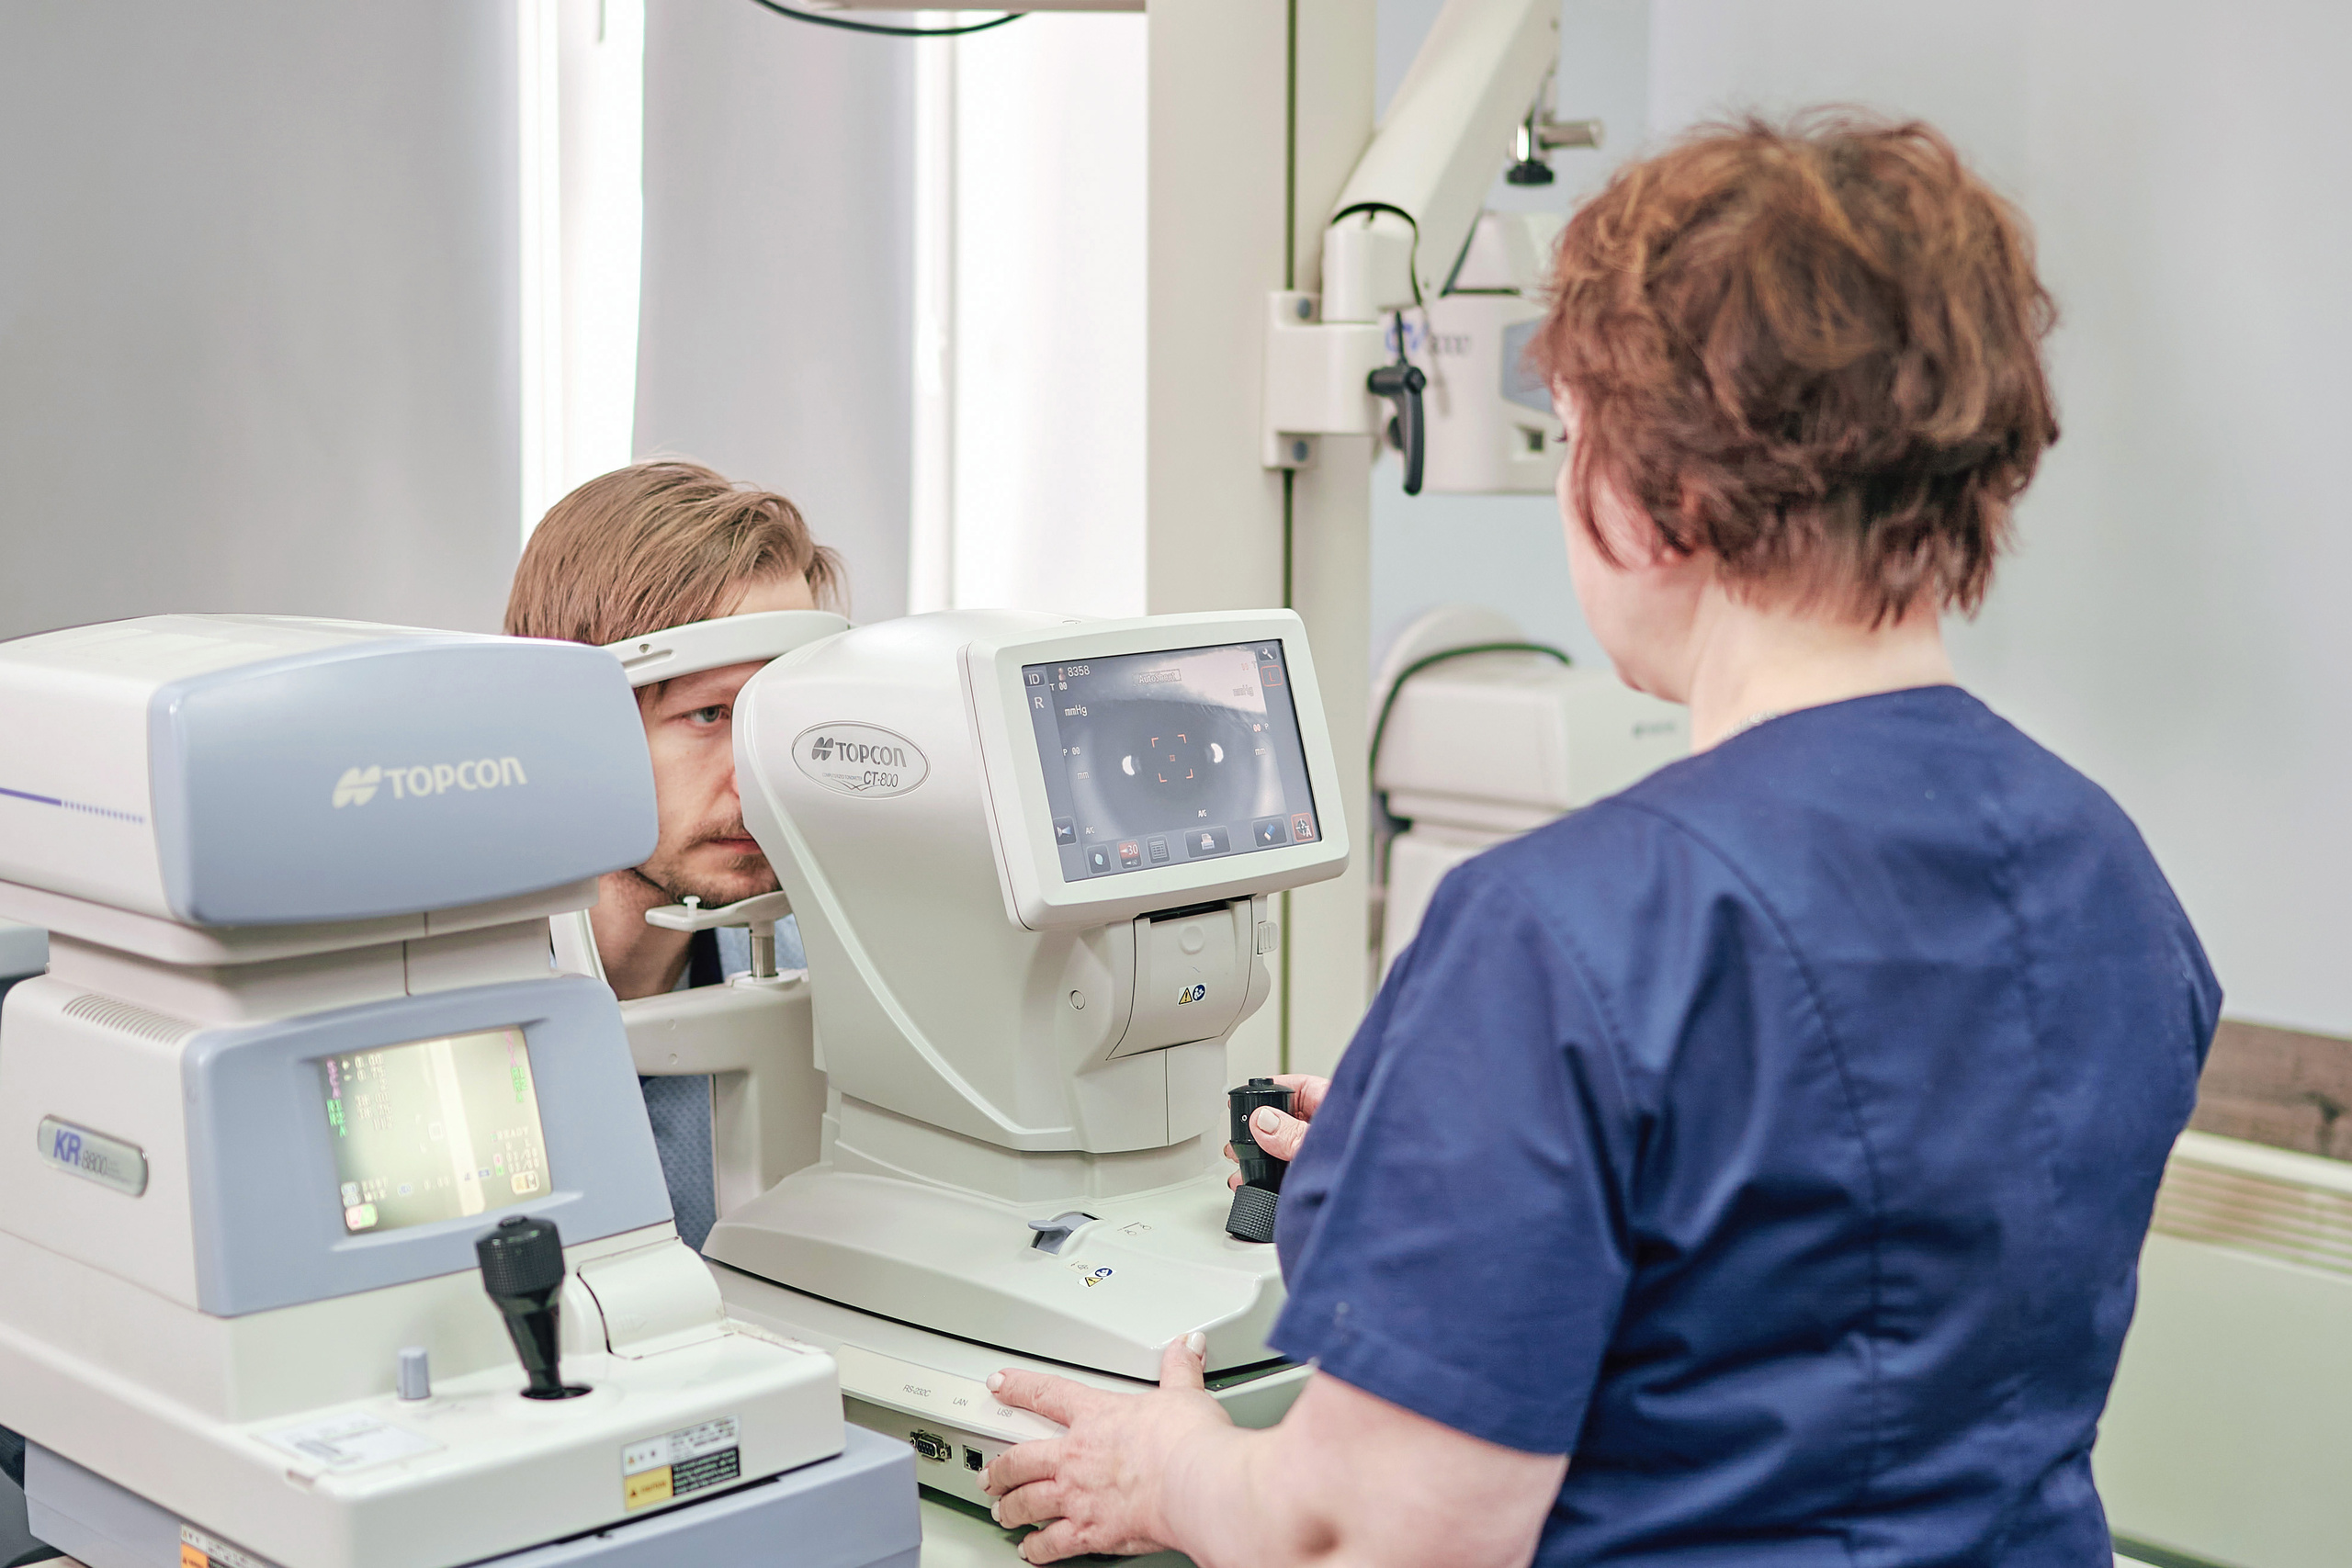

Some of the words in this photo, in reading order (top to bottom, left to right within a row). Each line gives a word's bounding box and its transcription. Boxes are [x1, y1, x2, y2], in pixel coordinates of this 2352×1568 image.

[1067, 665, 1091, 677] 8358
[1028, 674, 1040, 685] ID
[1034, 696, 1045, 709] R
[1064, 705, 1088, 716] mmHg
[834, 741, 907, 768] TOPCON
[383, 756, 529, 800] TOPCON
[863, 771, 899, 787] CT-800
[1127, 844, 1139, 855] 30
[53, 1129, 82, 1166] KR
[902, 1384, 932, 1398] RS-232C
[952, 1396, 968, 1407] LAN
[996, 1407, 1014, 1418] USB
